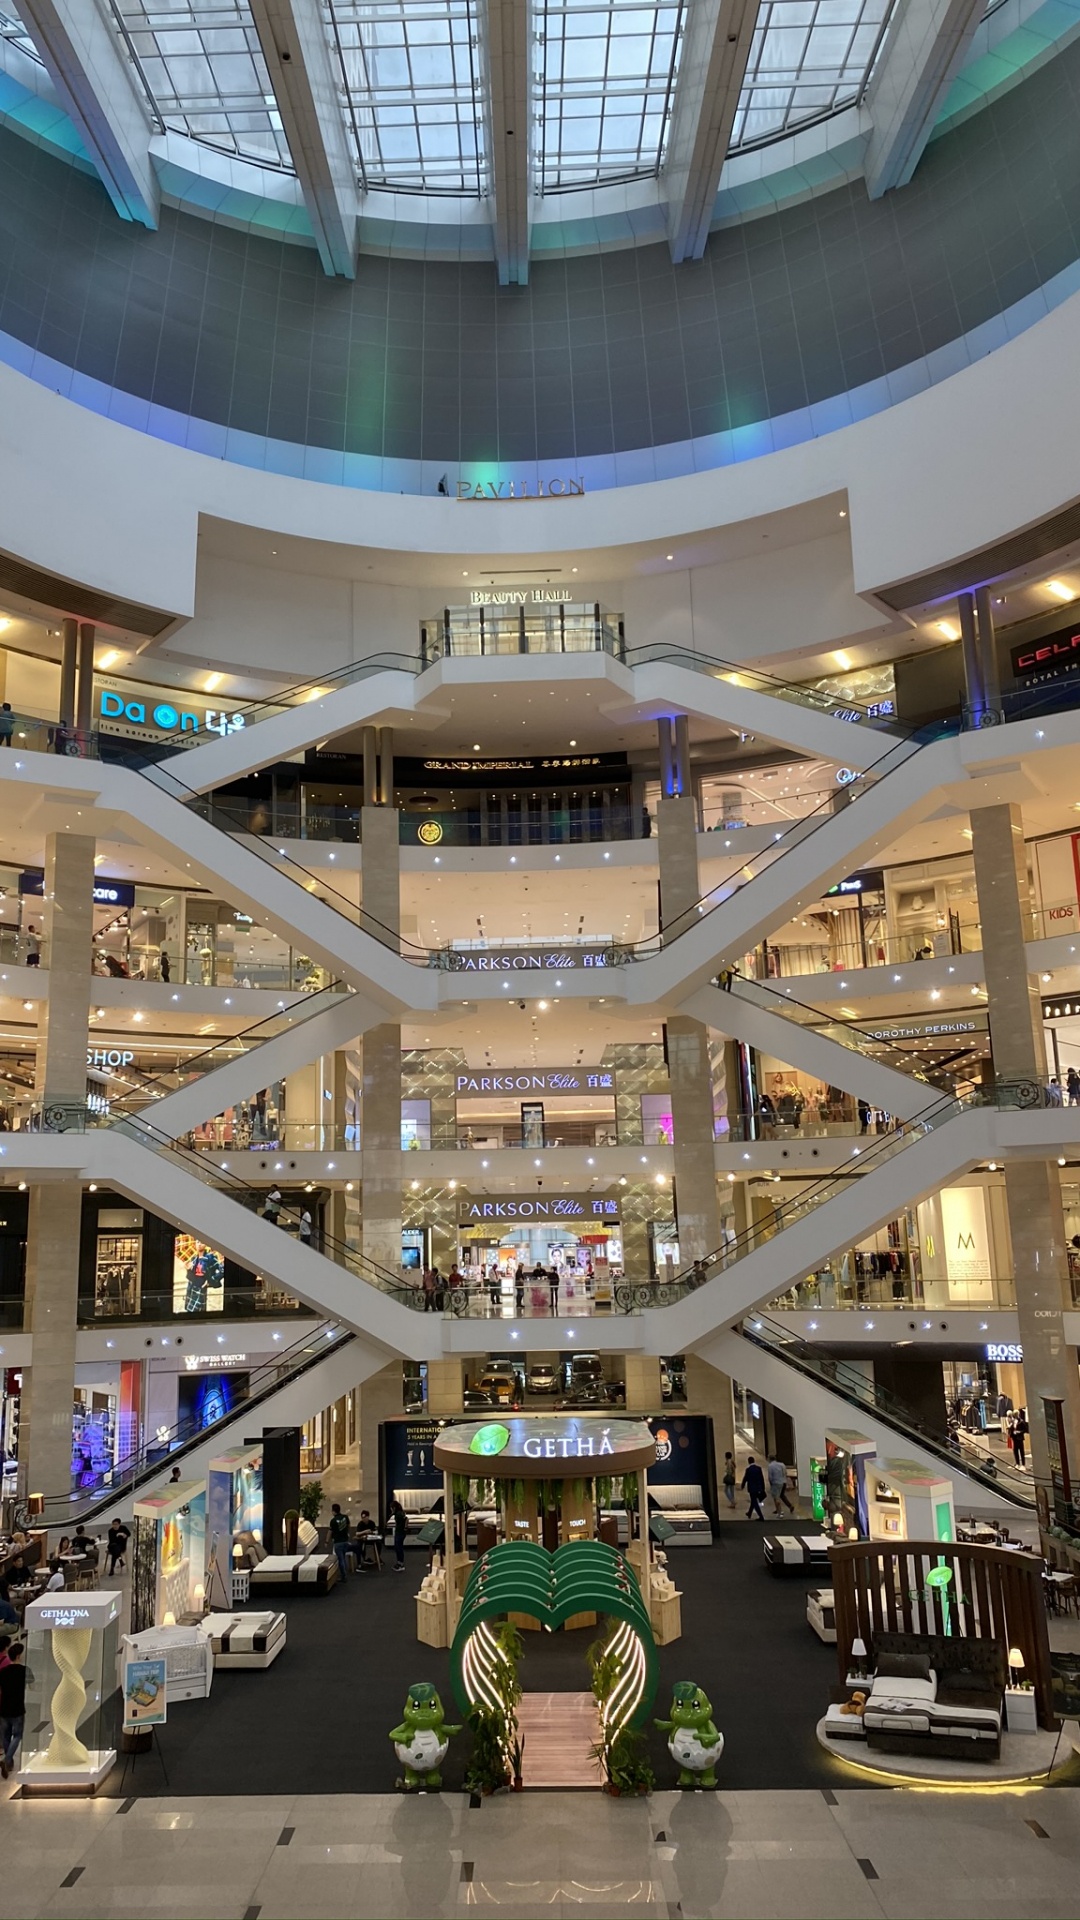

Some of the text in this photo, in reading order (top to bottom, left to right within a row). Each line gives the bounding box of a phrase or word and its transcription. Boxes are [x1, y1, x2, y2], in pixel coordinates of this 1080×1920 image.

[457, 477, 585, 500] PAVILION
[470, 589, 572, 605] BEAUTY HALL
[100, 691, 199, 732] Da On
[423, 761, 471, 770] GRAND
[1049, 906, 1073, 920] KIDS
[543, 953, 577, 969] Elite
[866, 1021, 976, 1040] DOROTHY PERKINS
[86, 1048, 134, 1067] SHOP
[457, 1073, 580, 1091] PARKSON Elite
[586, 1073, 613, 1088] 百盛
[459, 1199, 585, 1217] PARKSON Elite
[591, 1200, 618, 1214] 百盛
[957, 1232, 976, 1249] M
[200, 1355, 220, 1363] SWISS
[986, 1344, 1024, 1358] BOSS
[514, 1519, 586, 1529] TASTE TOUCH
